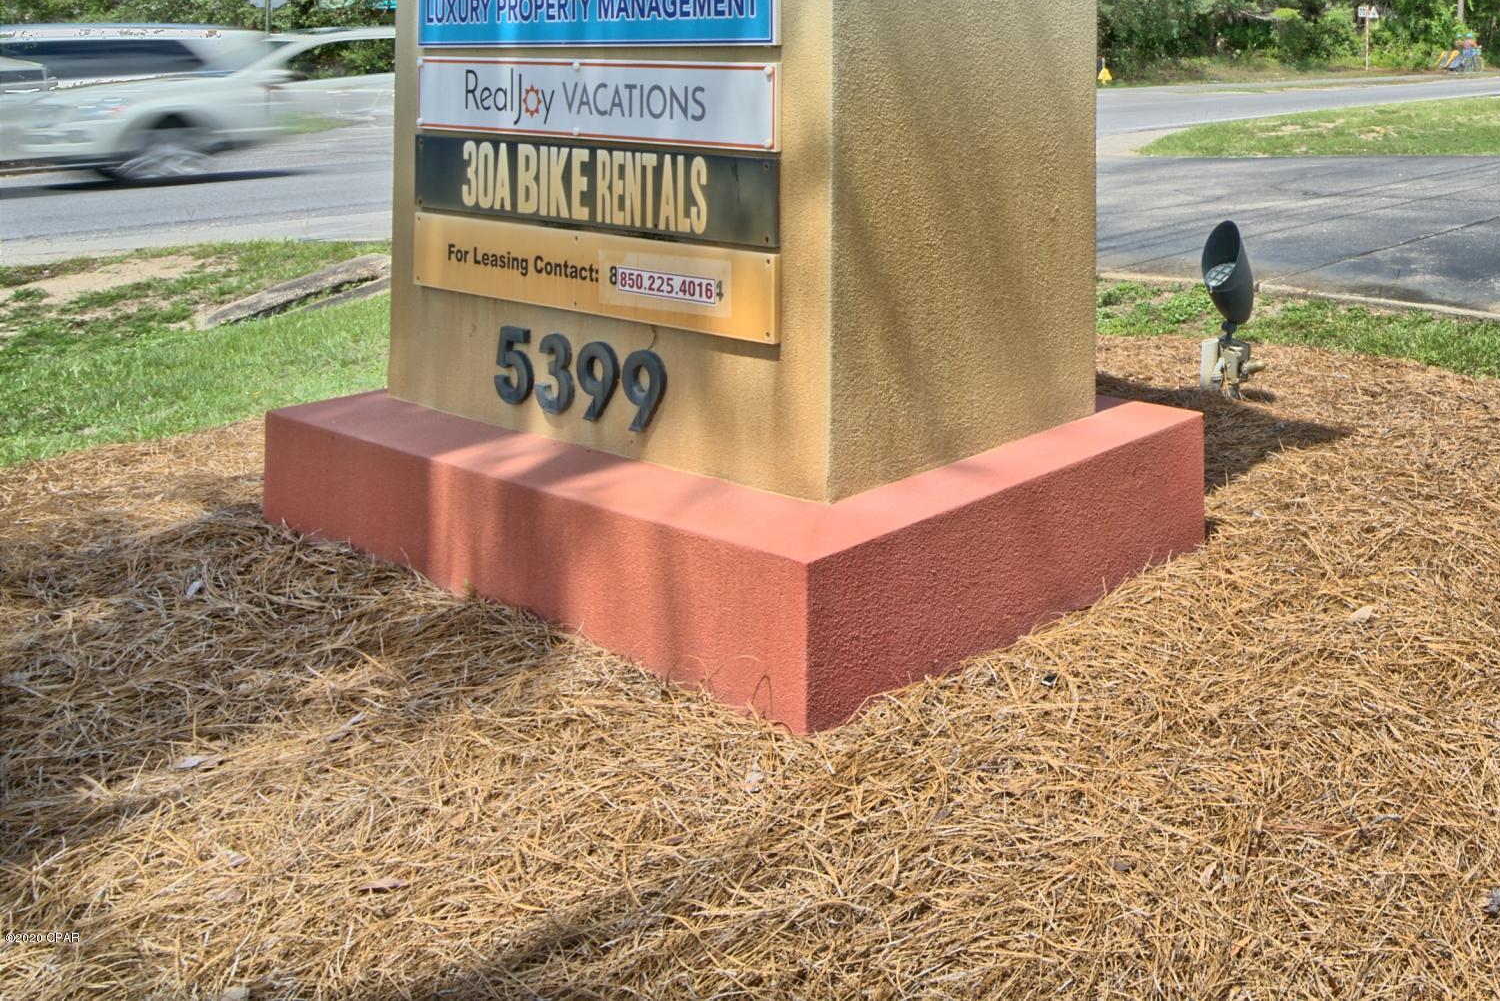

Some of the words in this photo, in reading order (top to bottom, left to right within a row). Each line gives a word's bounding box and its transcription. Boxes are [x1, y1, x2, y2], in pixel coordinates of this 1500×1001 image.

[562, 81, 706, 122] VACATIONS
[462, 140, 511, 212] 30A
[517, 143, 590, 222] BIKE
[597, 150, 708, 235] RENTALS
[447, 243, 469, 263] For
[473, 247, 528, 276] Leasing
[534, 255, 599, 283] Contact:
[619, 271, 714, 300] 850.225.4016
[494, 325, 668, 432] 5399
